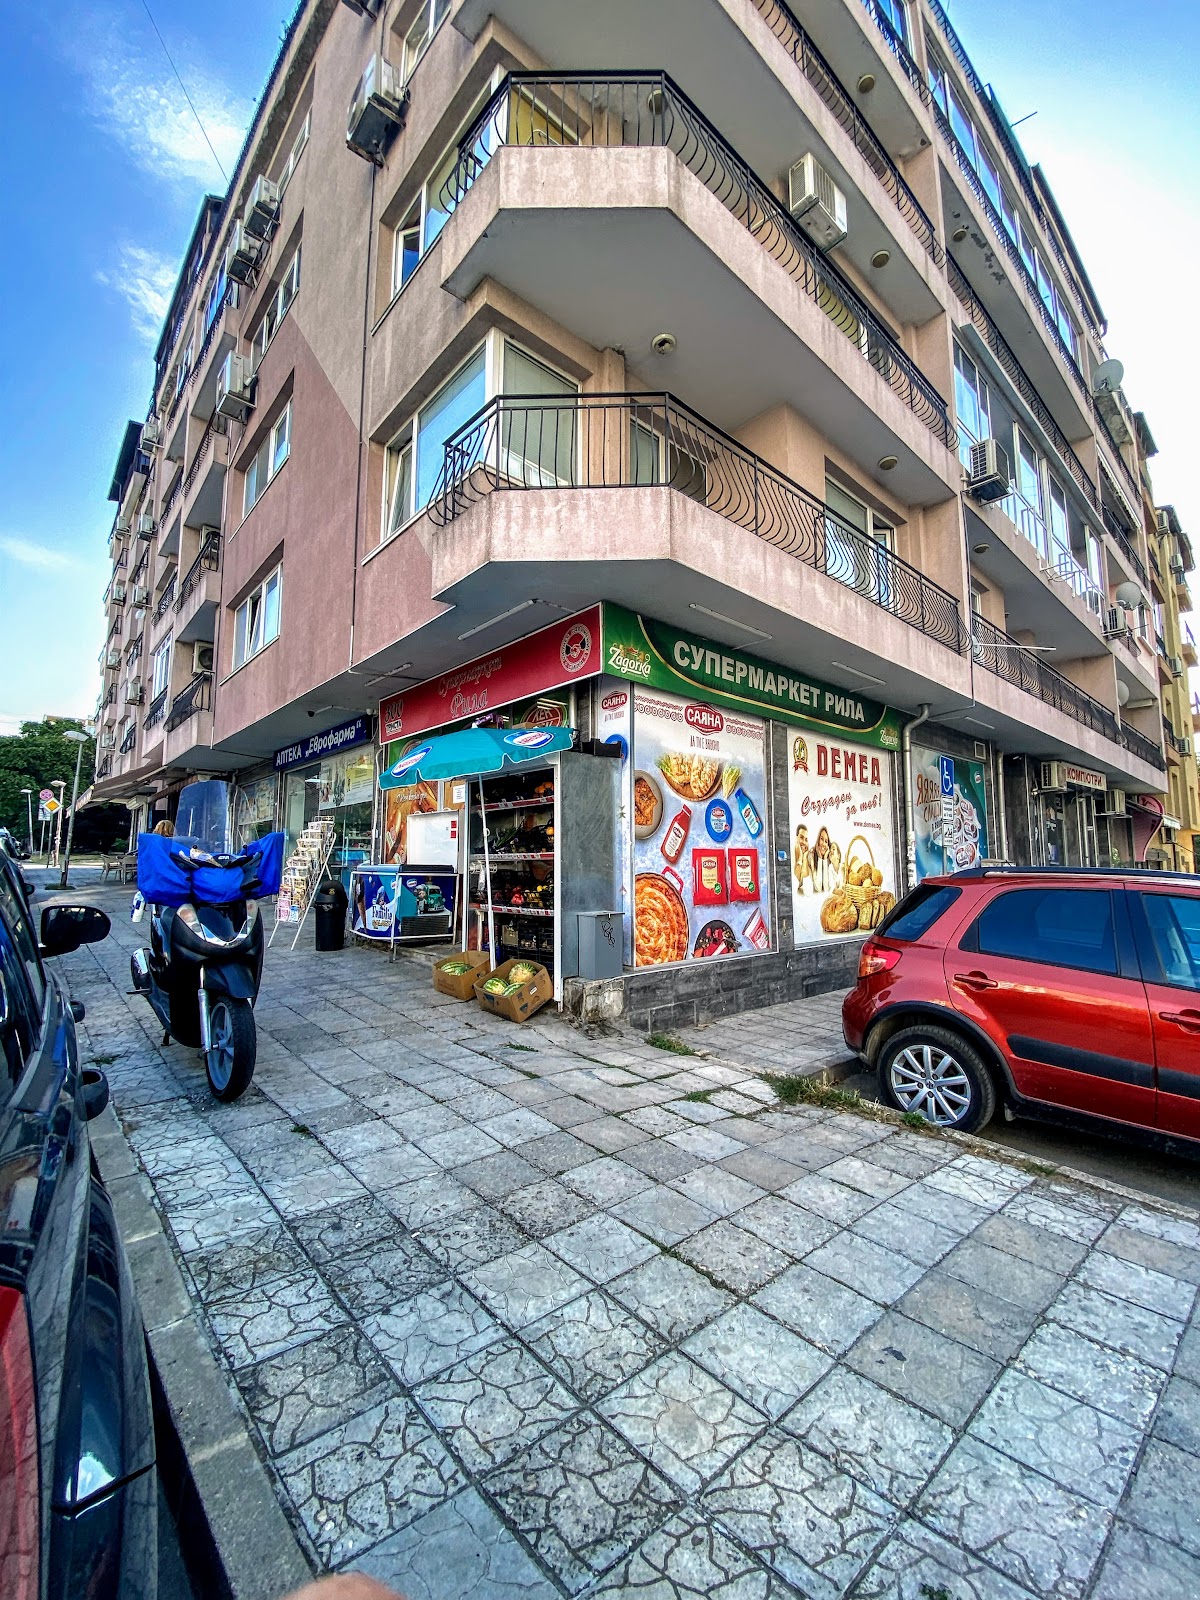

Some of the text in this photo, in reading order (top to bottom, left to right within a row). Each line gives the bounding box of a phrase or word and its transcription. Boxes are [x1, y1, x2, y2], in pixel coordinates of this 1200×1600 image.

[607, 645, 650, 677] Zagorka
[673, 640, 865, 722] СУПЕРМАРКЕТ РИЛА
[602, 693, 626, 708] САЯНА
[687, 708, 722, 729] САЯНА
[276, 744, 302, 767] АПТЕКА
[816, 744, 882, 786] DEMEA
